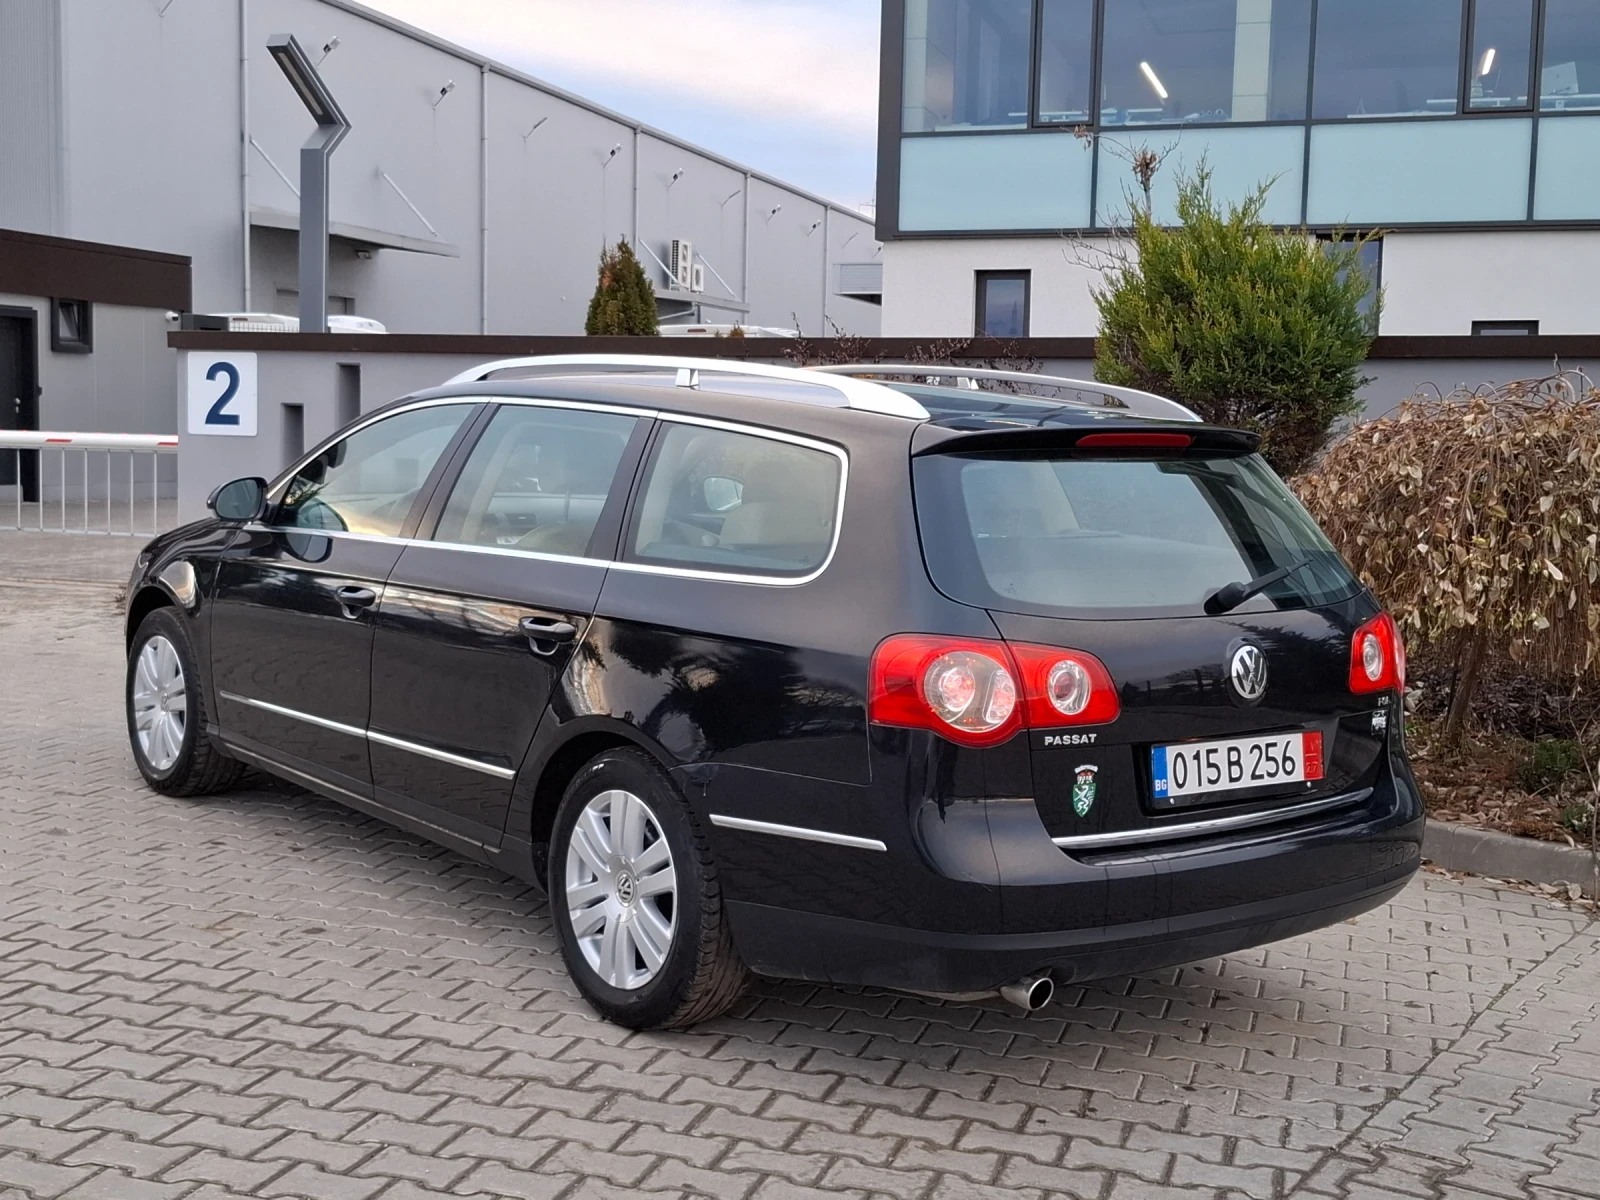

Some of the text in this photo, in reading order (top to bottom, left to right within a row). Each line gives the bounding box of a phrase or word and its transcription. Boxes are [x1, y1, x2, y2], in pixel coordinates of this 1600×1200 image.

[205, 361, 241, 426] 2
[1232, 645, 1266, 699] VW
[1044, 733, 1097, 746] PASSAT
[1155, 779, 1168, 792] BG
